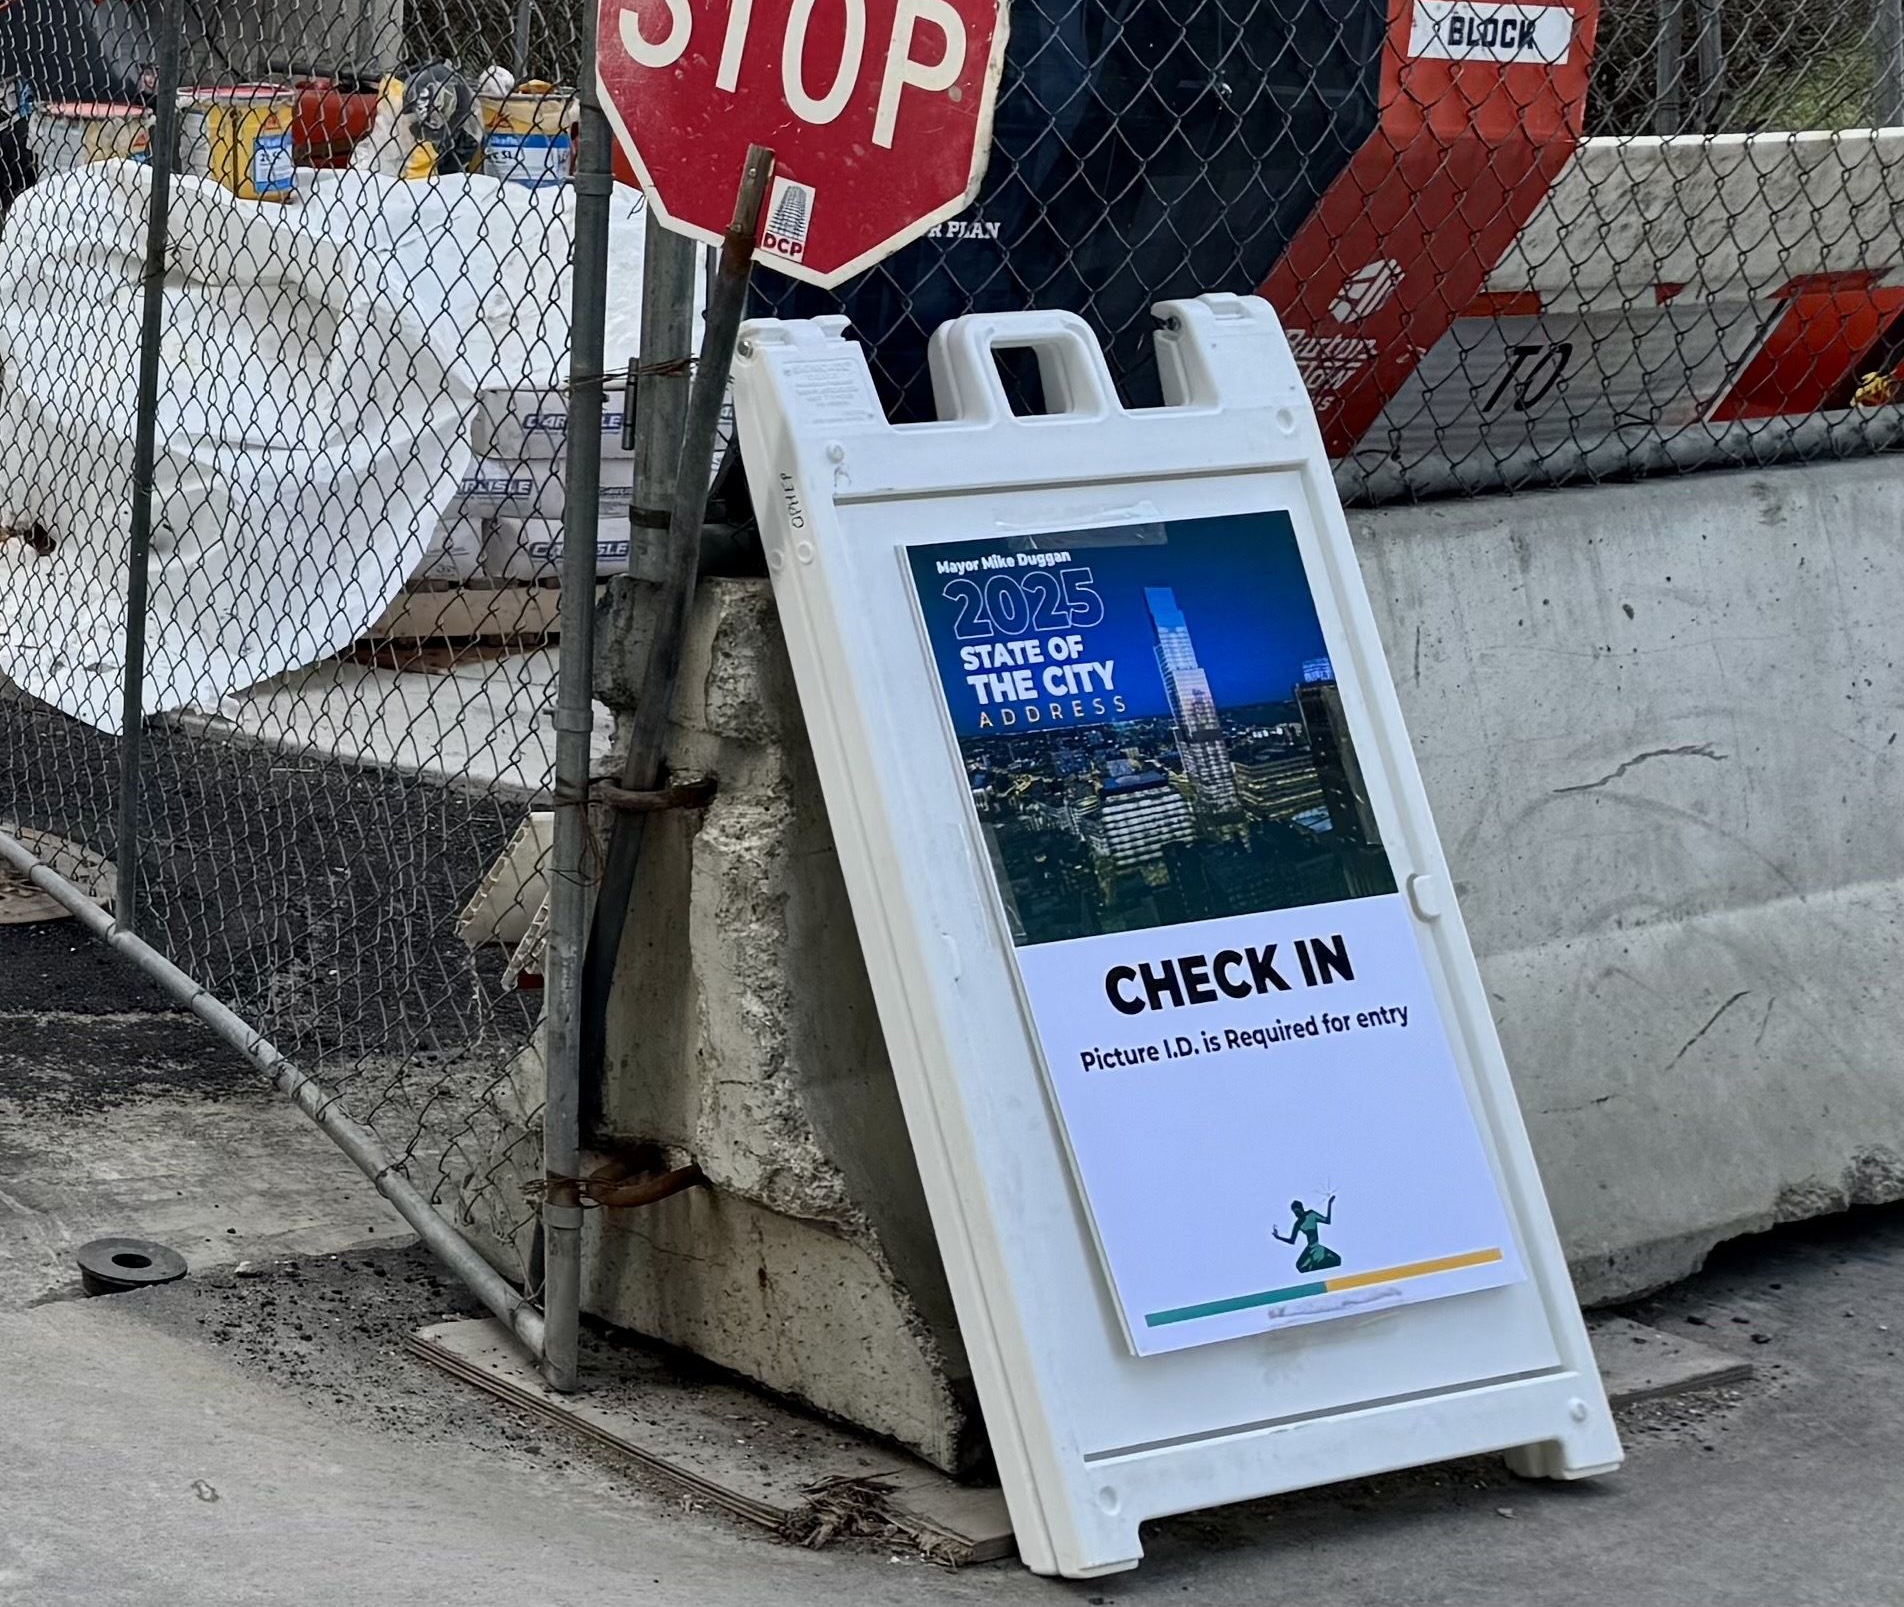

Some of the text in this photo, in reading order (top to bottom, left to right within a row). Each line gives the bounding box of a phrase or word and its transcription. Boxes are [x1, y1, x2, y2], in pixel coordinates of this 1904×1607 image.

[1447, 16, 1537, 50] BLOCK
[763, 232, 803, 256] DCP
[1482, 343, 1573, 412] TO
[936, 551, 1071, 575] Mayor Mike Duggan
[942, 567, 1105, 640] 2025
[960, 635, 1084, 671] STATE OF
[966, 660, 1115, 705] THE CITY
[979, 695, 1126, 729] ADDRESS
[1105, 934, 1355, 1015] CHECK IN
[1080, 1003, 1410, 1073] Picture I.D. is Required for entry
